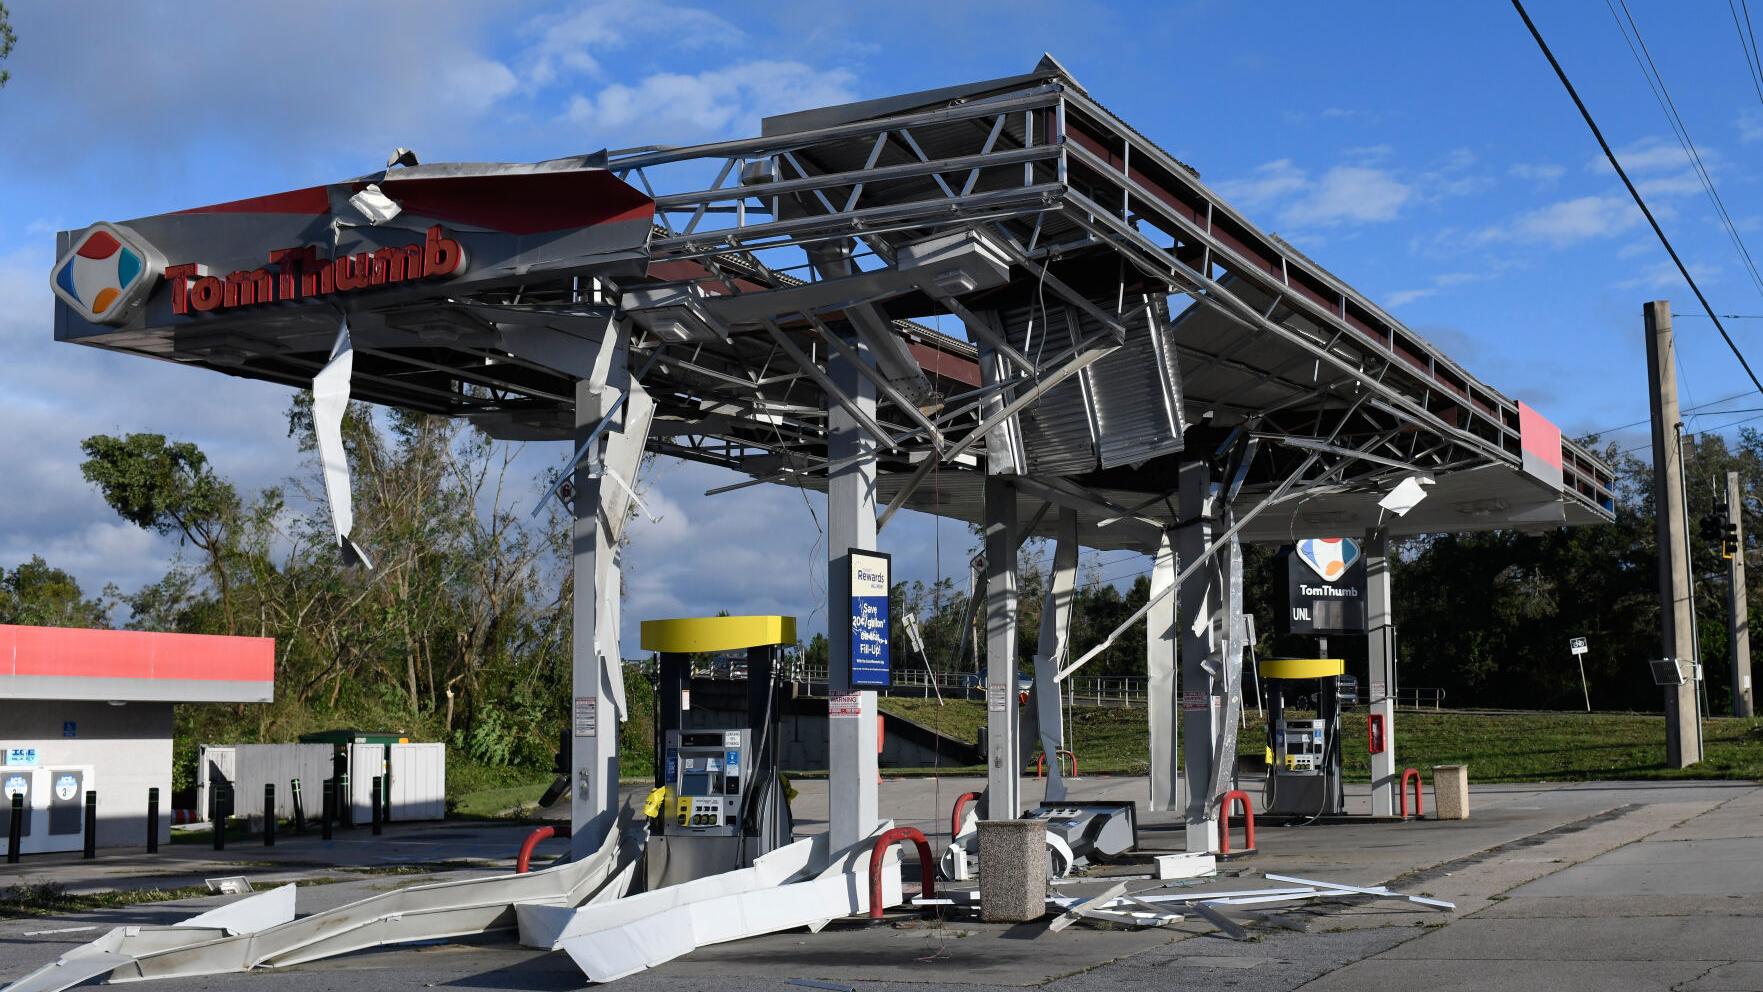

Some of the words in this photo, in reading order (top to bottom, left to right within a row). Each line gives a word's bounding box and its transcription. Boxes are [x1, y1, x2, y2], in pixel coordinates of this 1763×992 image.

[164, 224, 464, 314] TomThumb
[858, 570, 885, 583] Rewards
[1300, 584, 1358, 597] TomThumb
[863, 602, 878, 614] Save
[1292, 607, 1312, 621] UNL
[62, 787, 67, 797] 3
